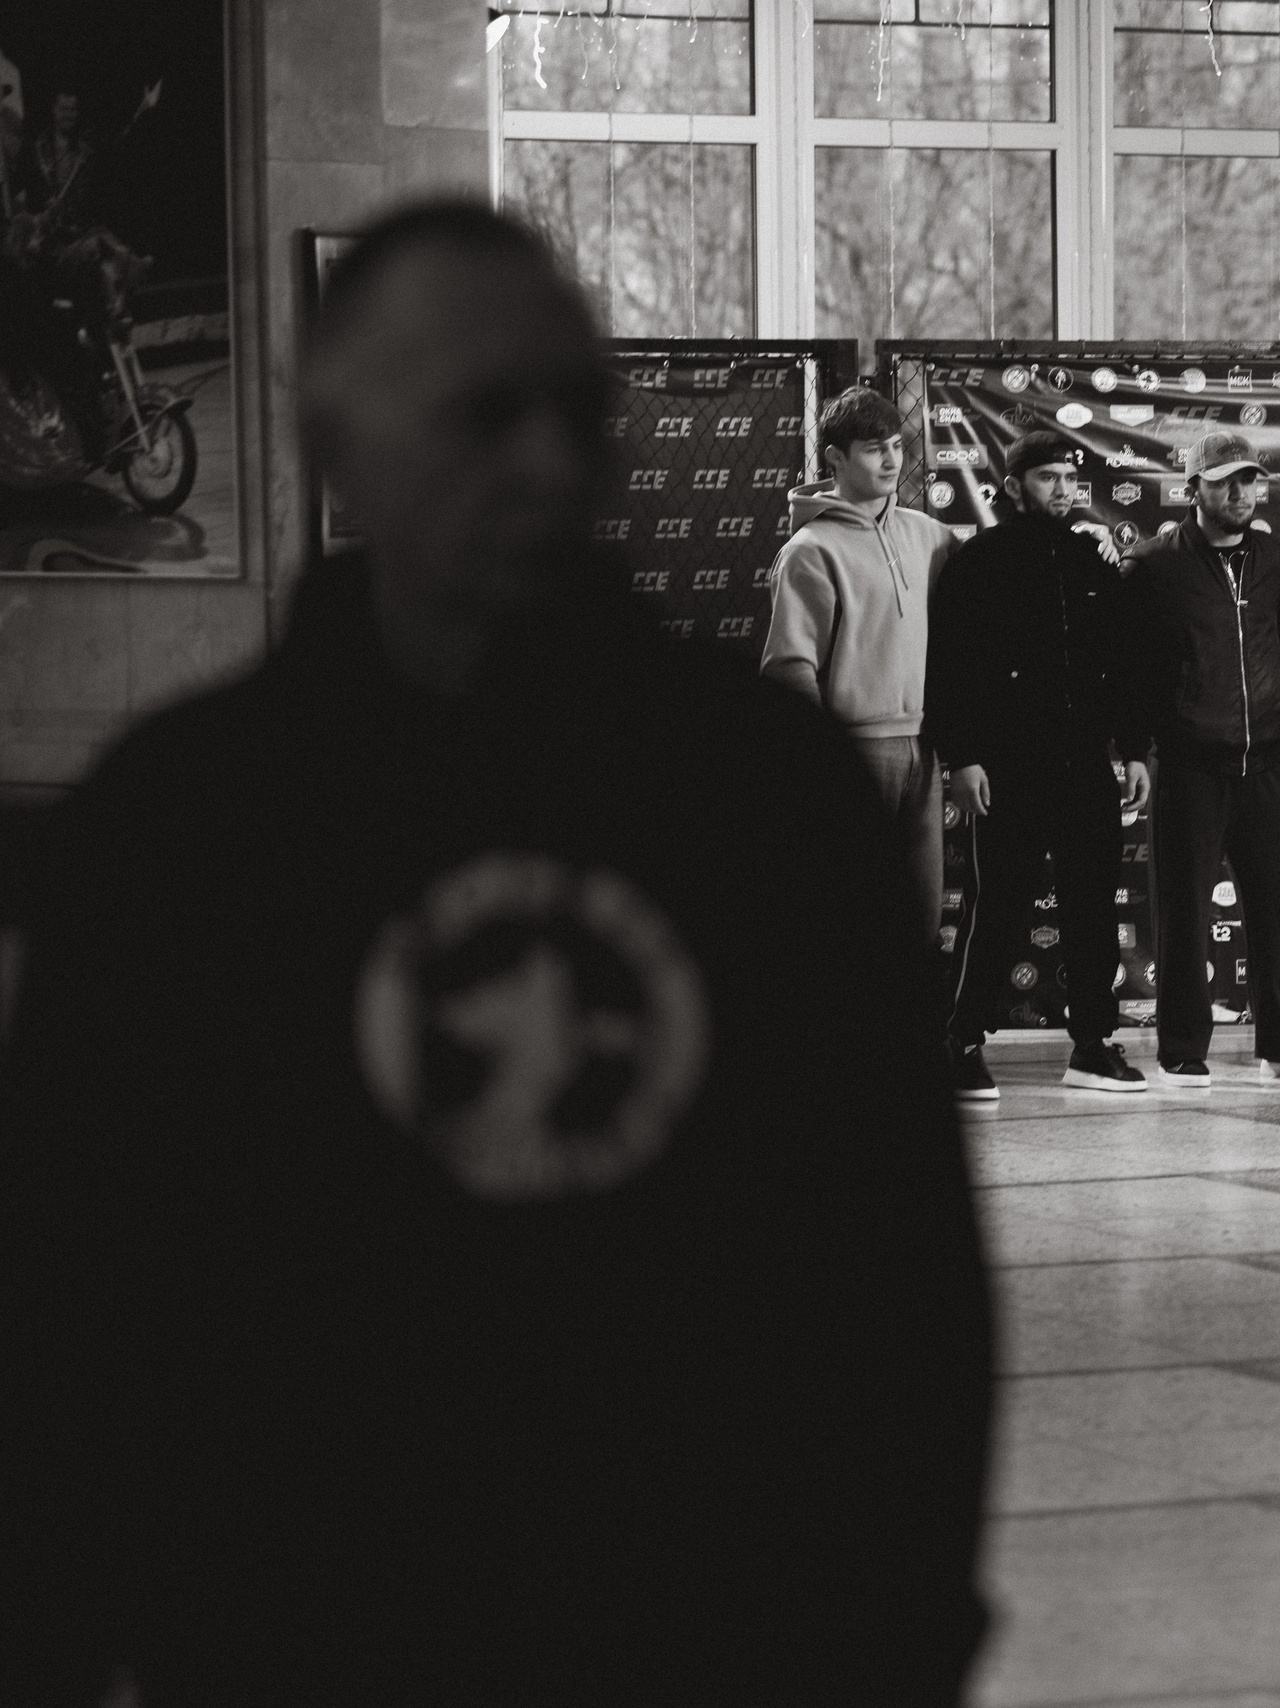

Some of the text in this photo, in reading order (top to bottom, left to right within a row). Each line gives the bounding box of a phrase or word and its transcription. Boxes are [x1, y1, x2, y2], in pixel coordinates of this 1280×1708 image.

[629, 368, 789, 388] CCE CCE CCE
[930, 368, 985, 386] CCE
[655, 417, 692, 438] CCE
[716, 417, 752, 437] CCE
[776, 417, 805, 436] CC
[629, 468, 789, 490] CCE CCE CCE
[655, 518, 693, 538] CCE
[717, 517, 754, 537] CCE
[632, 571, 670, 591] CCE
[692, 569, 730, 590] CCE
[1121, 844, 1148, 861] CE
